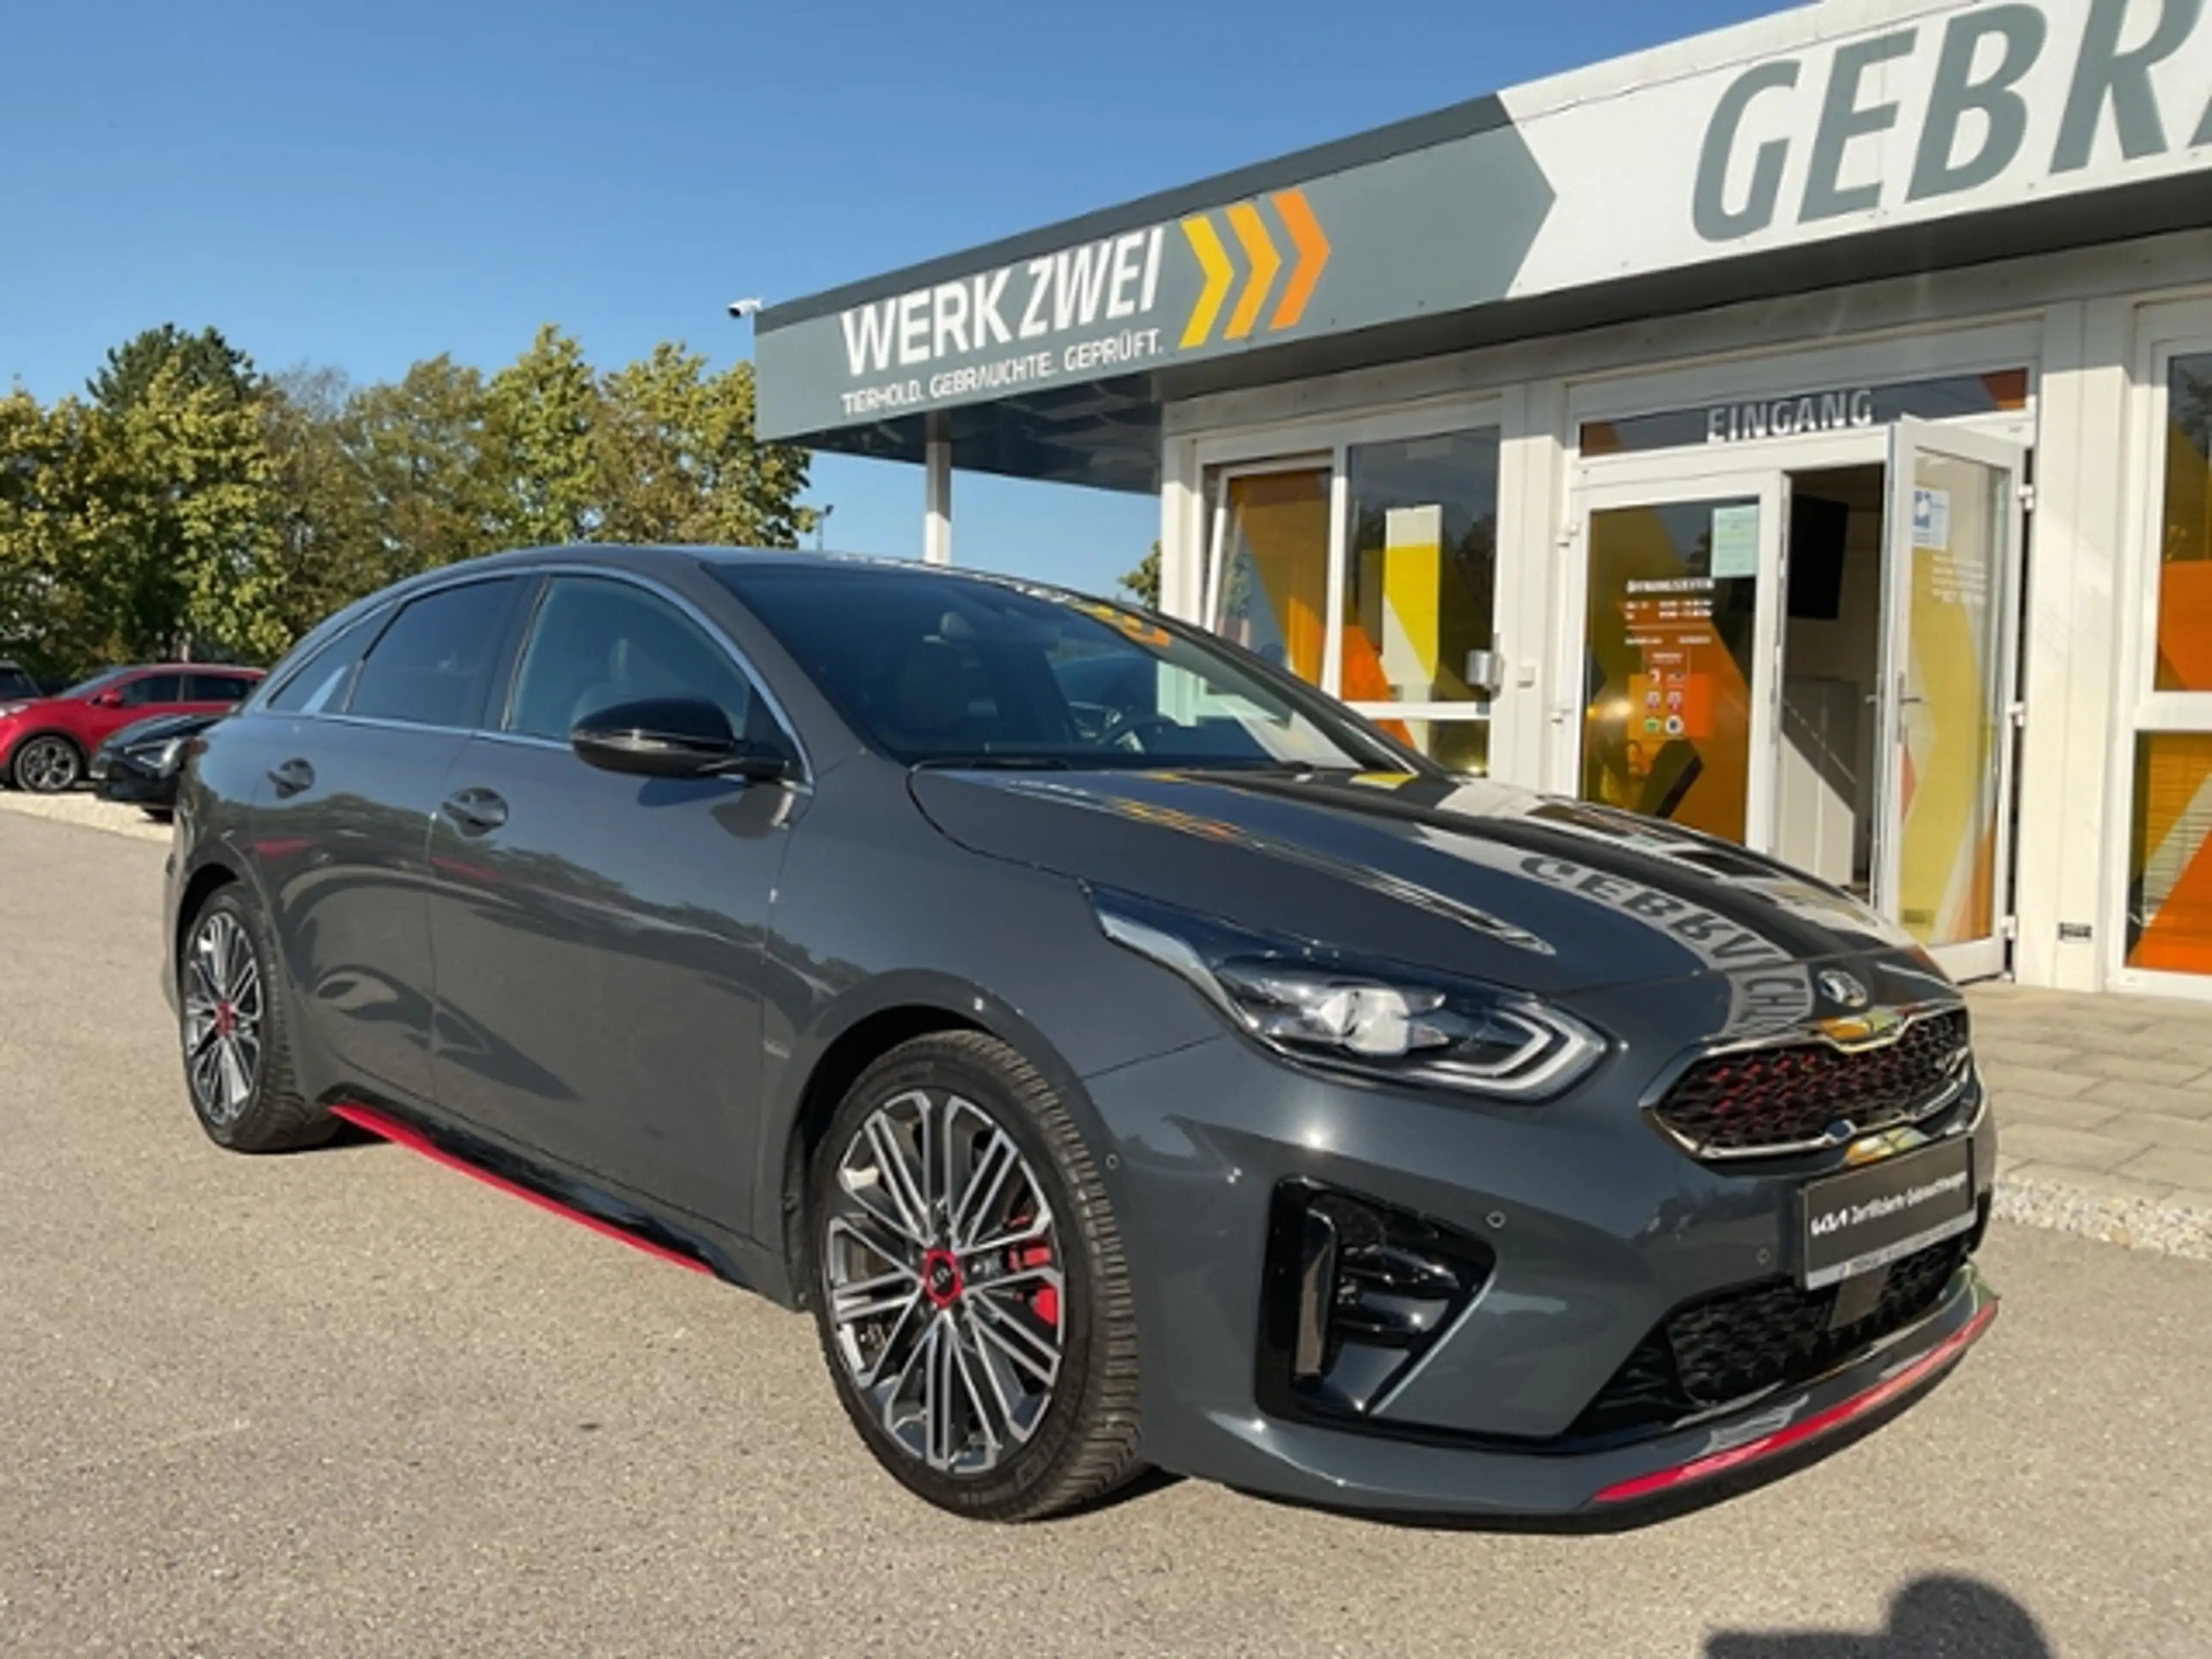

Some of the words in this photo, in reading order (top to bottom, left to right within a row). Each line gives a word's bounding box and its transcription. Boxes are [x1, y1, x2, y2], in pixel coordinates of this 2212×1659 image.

[1691, 0, 2212, 242] GEBR
[840, 267, 1012, 377] WERK
[1018, 226, 1166, 341] ZWEI
[1063, 328, 1164, 372] GEPRÜFT.
[1707, 389, 1872, 444] EINGANG
